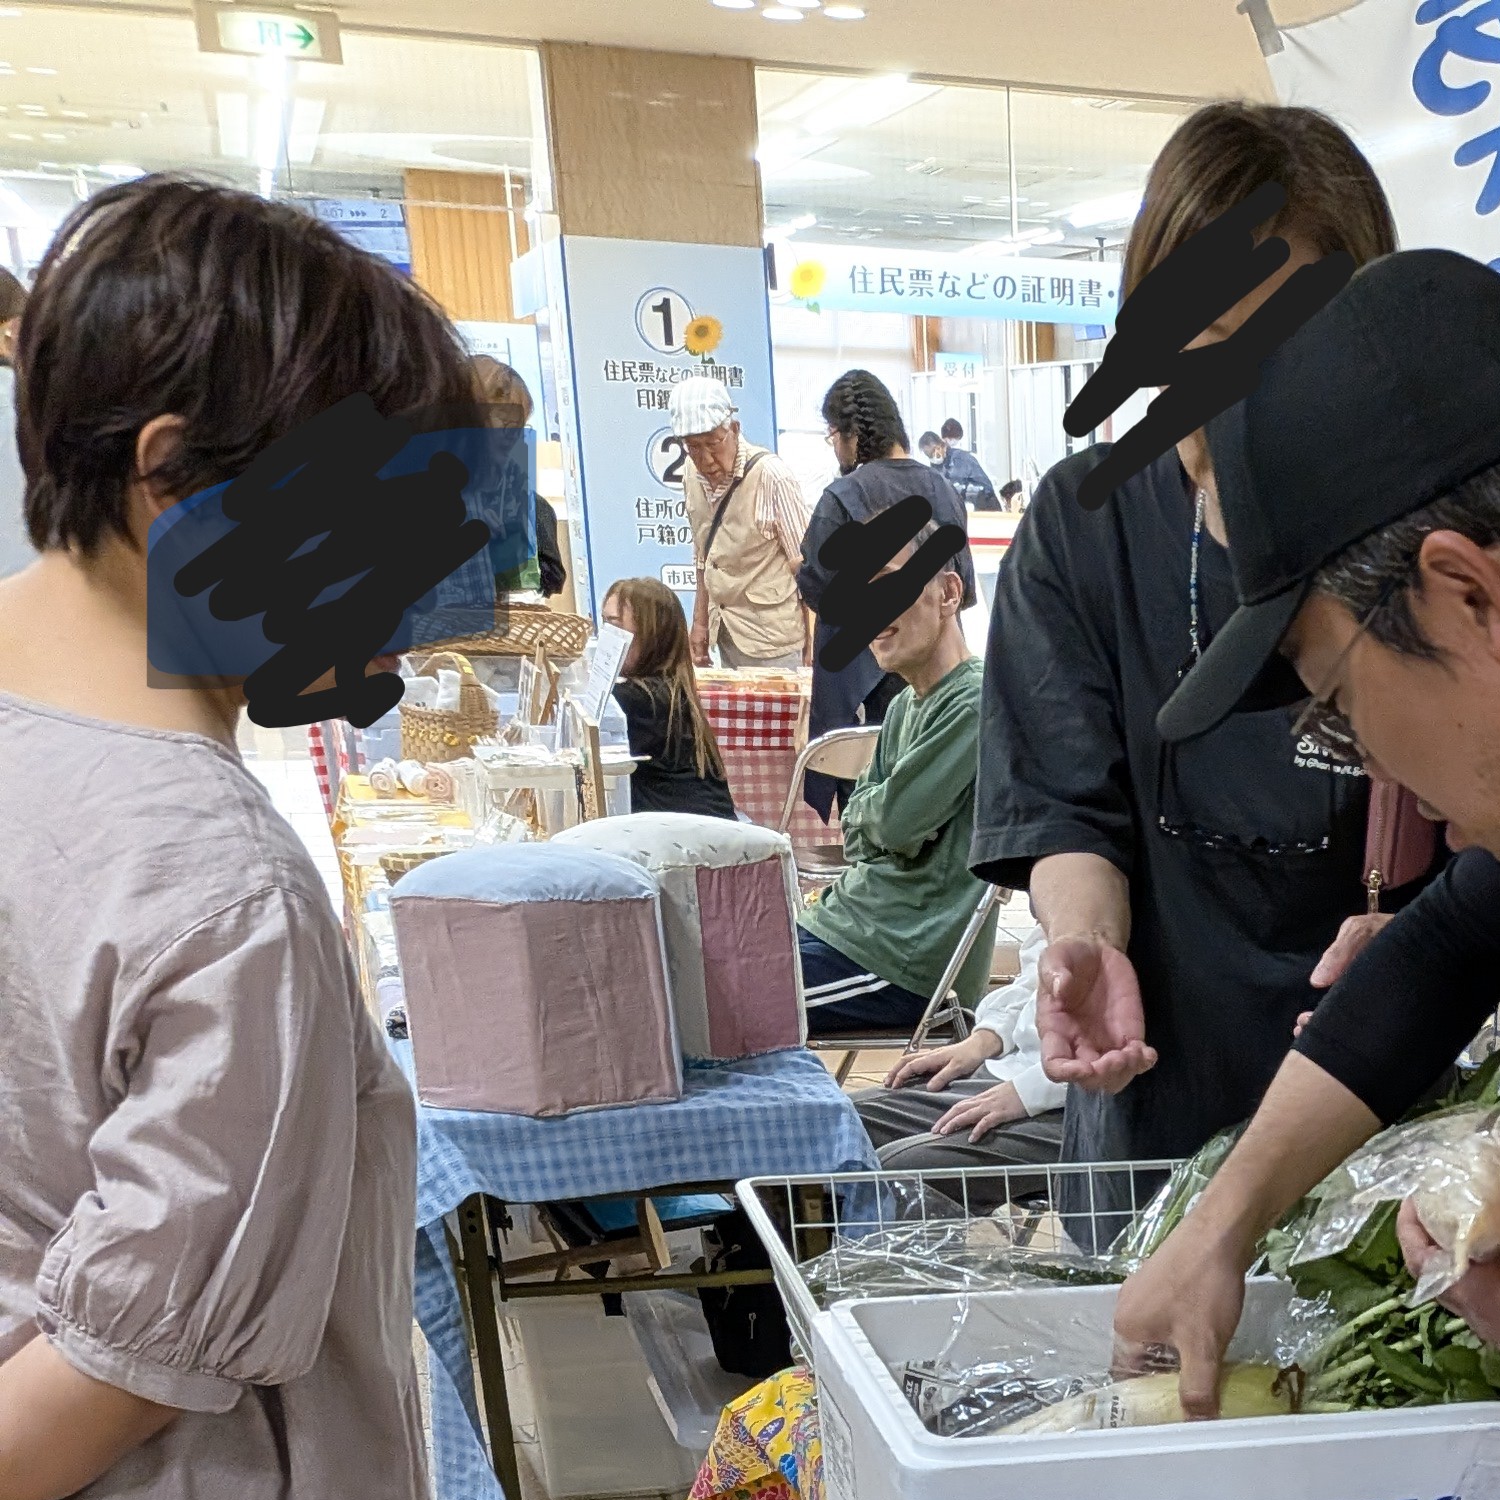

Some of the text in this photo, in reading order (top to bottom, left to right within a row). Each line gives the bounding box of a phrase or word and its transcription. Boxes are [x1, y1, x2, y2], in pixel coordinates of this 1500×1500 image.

[651, 297, 674, 347] 1
[942, 361, 976, 379] 受付
[660, 435, 684, 484] 2
